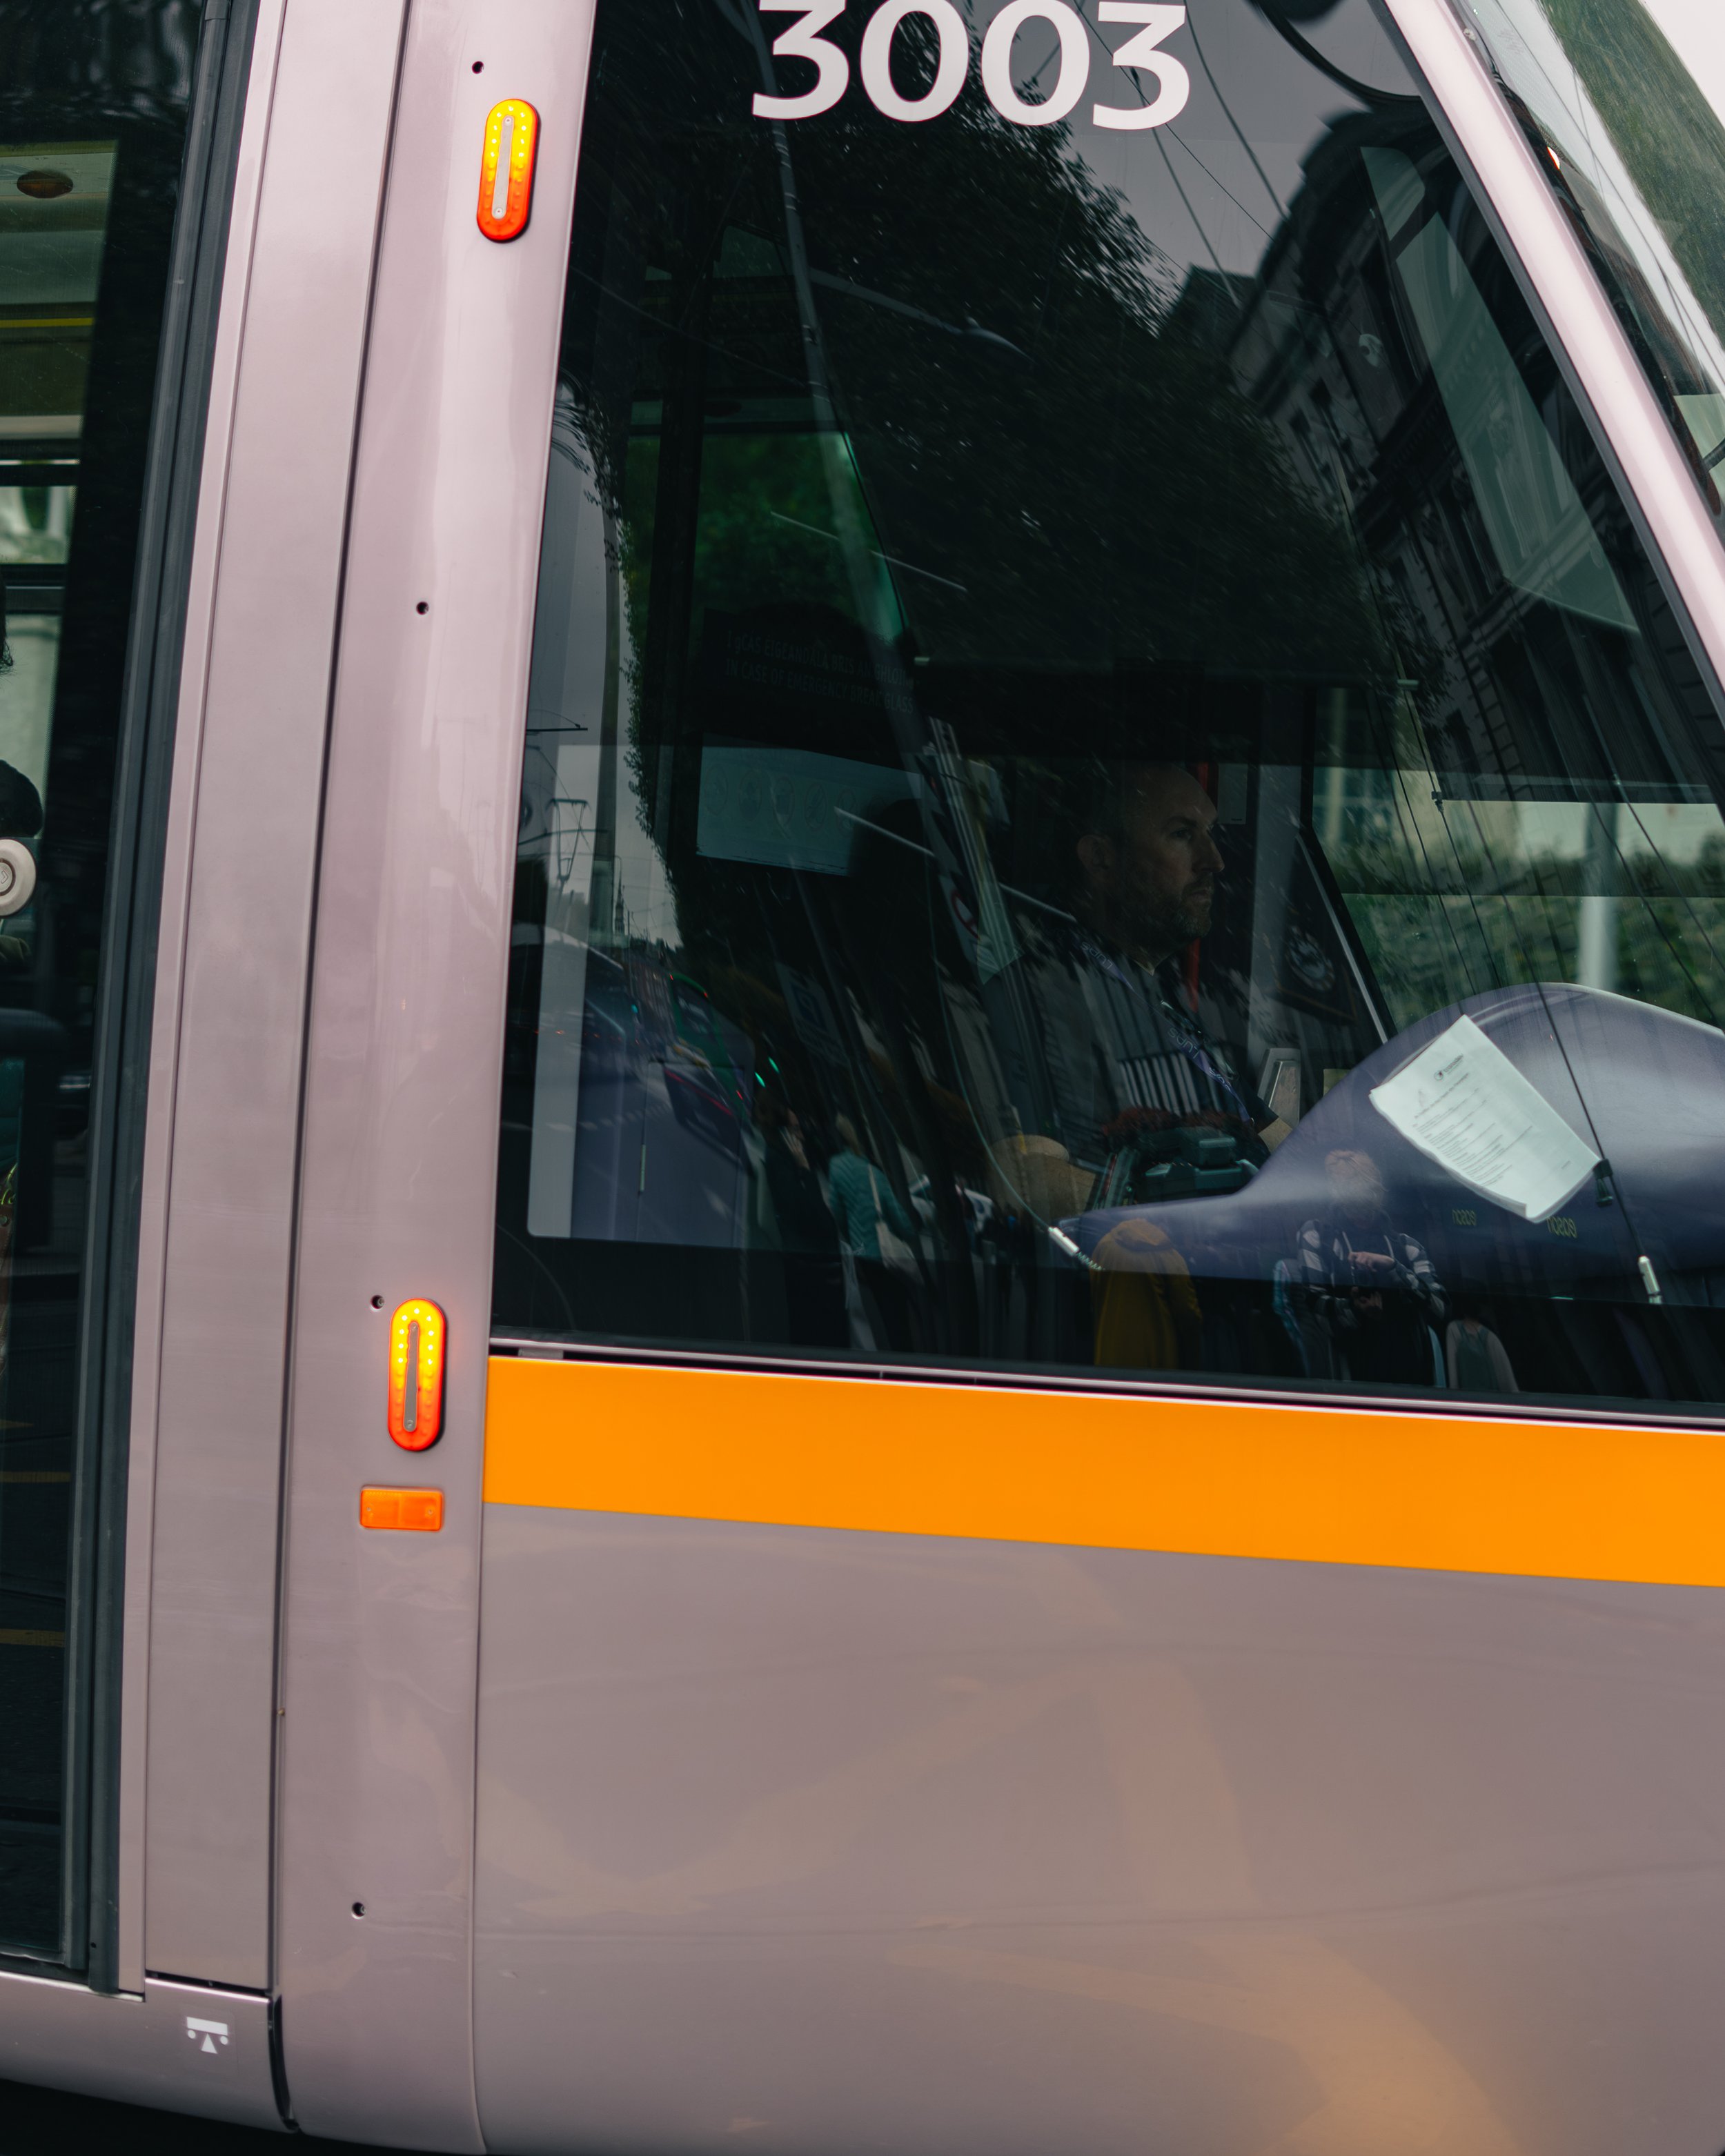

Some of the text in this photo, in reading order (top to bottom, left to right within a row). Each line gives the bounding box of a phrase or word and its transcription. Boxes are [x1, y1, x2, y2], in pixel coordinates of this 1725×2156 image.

[752, 0, 1190, 130] 3003
[726, 658, 914, 714] IN CASE OF EMERGENCY BREAK GLASS
